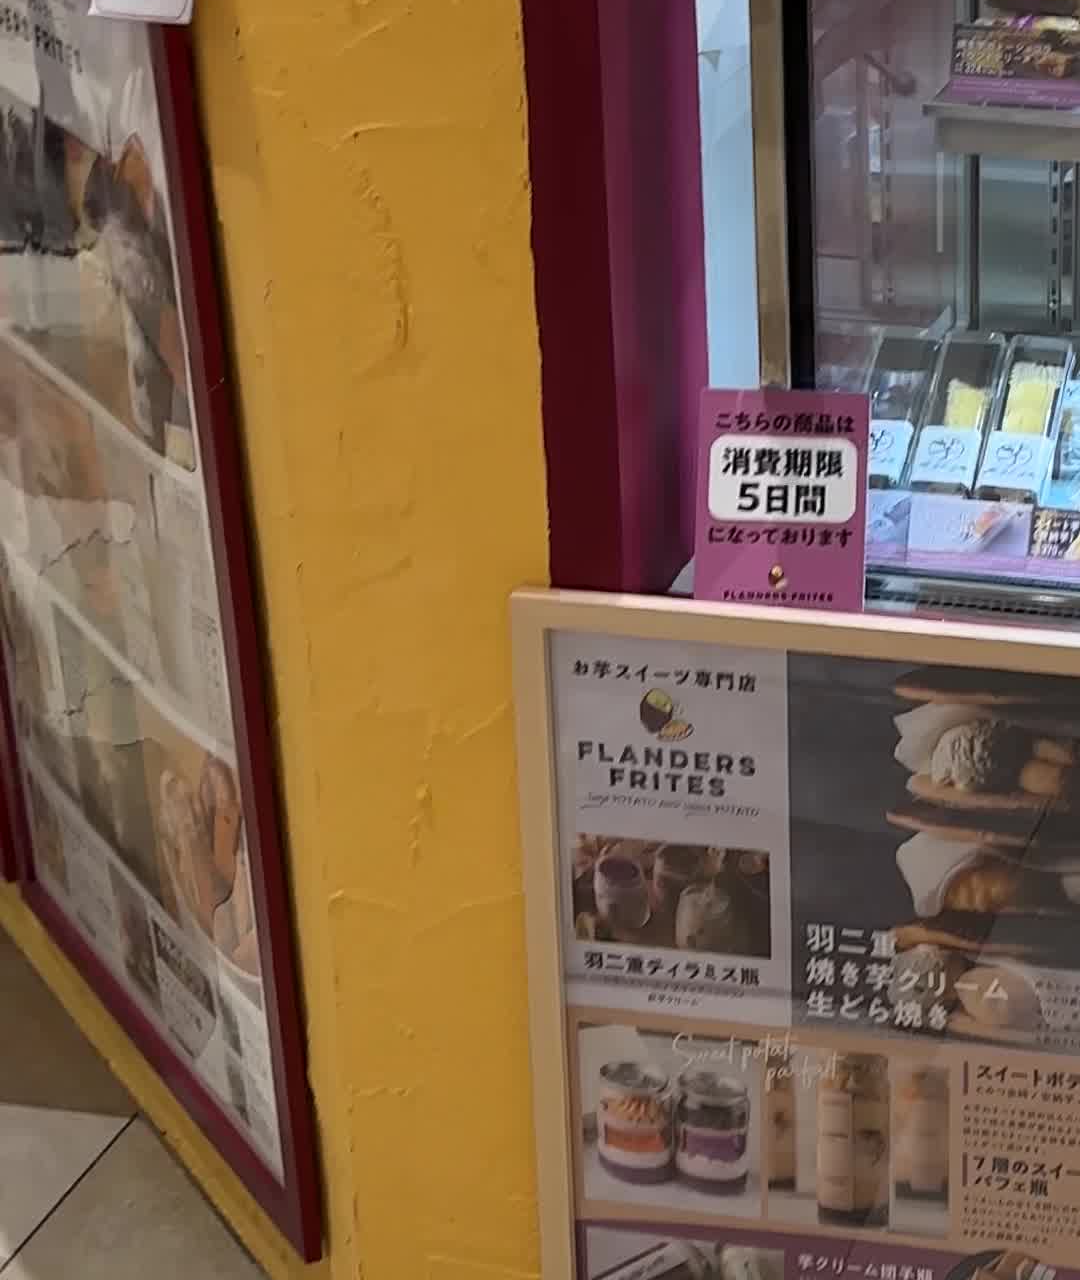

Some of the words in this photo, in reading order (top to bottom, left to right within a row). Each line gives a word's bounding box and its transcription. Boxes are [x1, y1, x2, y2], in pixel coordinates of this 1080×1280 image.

[715, 412, 856, 434] こちらの商品は
[722, 447, 844, 479] 消費期限
[737, 482, 827, 517] 5日間
[708, 526, 853, 548] になっております
[573, 659, 756, 693] お芋スイーツ専門店
[578, 740, 757, 777] FLANDERS
[609, 767, 727, 797] FRITES
[806, 922, 898, 959] 羽二重
[806, 957, 1010, 1001] 焼き芋クリーム
[806, 992, 949, 1031] 生どら焼き
